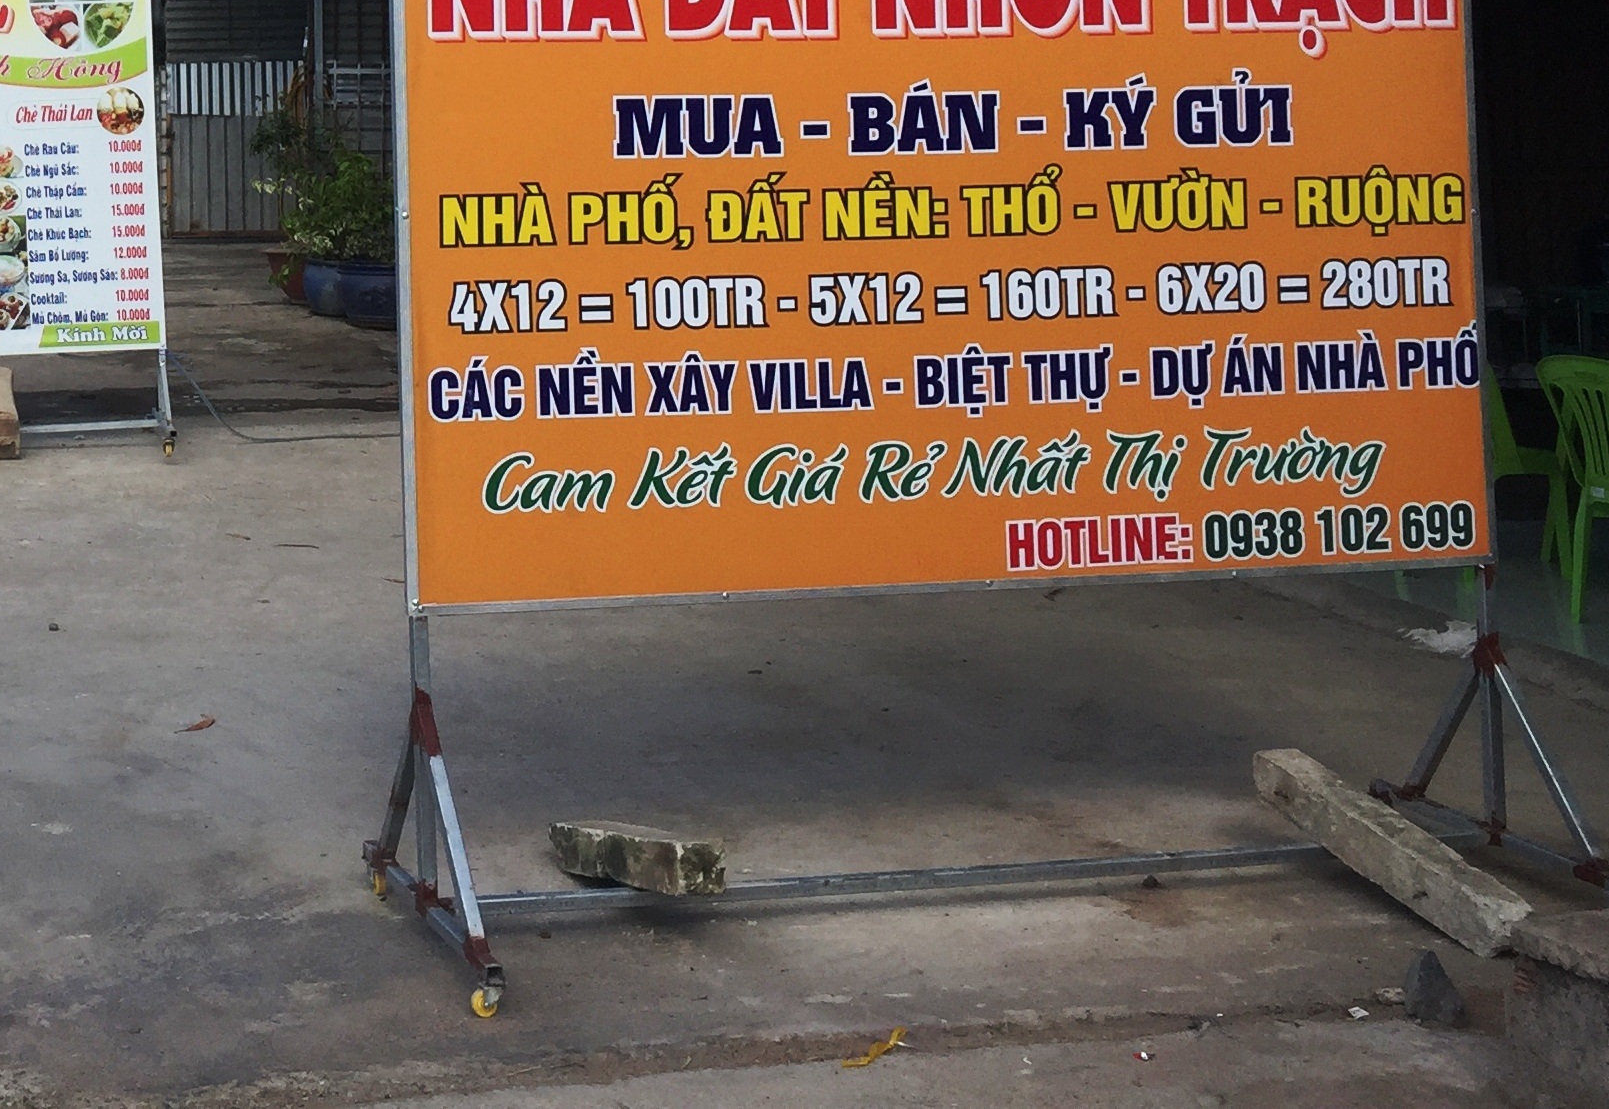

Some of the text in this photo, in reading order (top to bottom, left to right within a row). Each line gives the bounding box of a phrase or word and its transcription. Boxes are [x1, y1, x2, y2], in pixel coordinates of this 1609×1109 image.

[15, 103, 93, 124] Chè Thái Lan
[42, 143, 58, 155] Rau
[612, 67, 1294, 159] MUA BÁN KÝ GỬI
[65, 205, 82, 218] Lan:
[439, 163, 1466, 251] NHÀ PHỐ, ĐẤT NỀN: THỔ VƯỜN RUỘNG
[57, 270, 71, 284] Sa,
[447, 256, 1453, 335] 4X12 100TR 5X12 160TR 6X20 280TR
[427, 319, 1481, 423] CÁC NỀN XÂY VILLA BIỆT THỰ DỰ ÁN NHÀ PHỐ
[482, 425, 1387, 515] Cam Kết Giá Rẻ Nhất Thị Trường
[1004, 500, 1476, 573] HOTLINE: 0938 102 699
